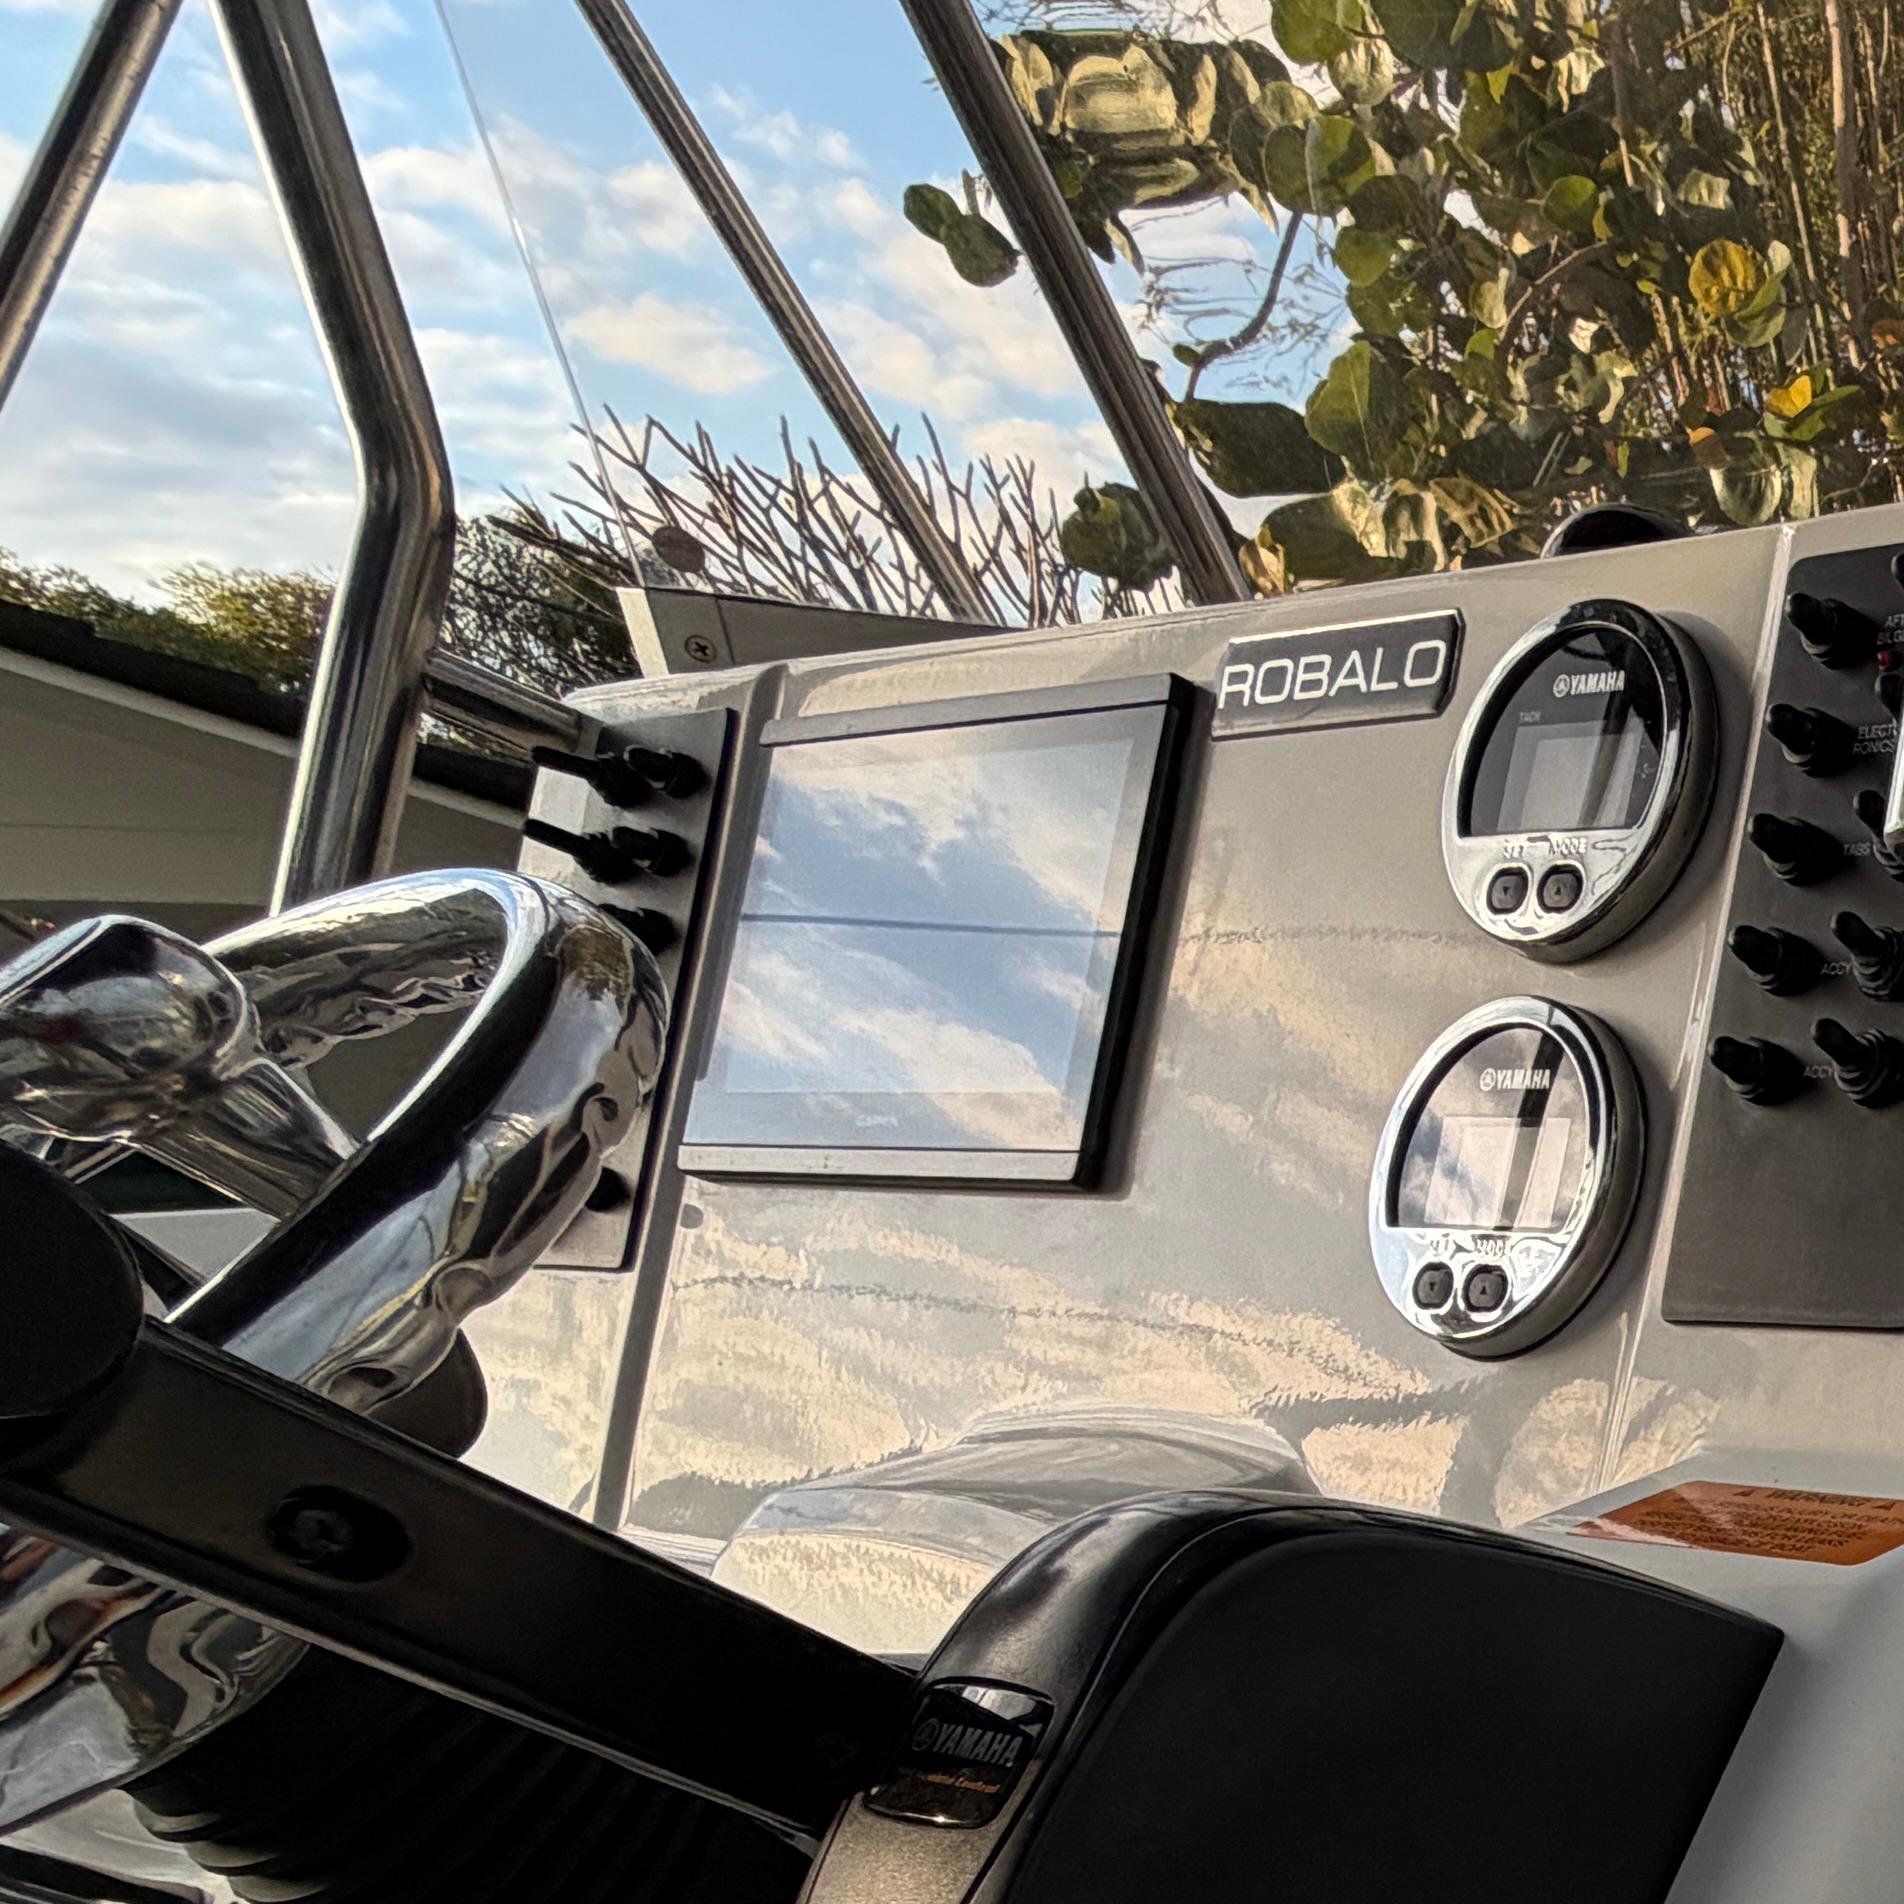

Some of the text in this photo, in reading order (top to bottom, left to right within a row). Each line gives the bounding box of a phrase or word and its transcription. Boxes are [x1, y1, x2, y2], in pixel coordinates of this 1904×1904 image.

[1217, 639, 1446, 710] ROBALO
[1570, 669, 1625, 695] YAMAHA
[1496, 1068, 1550, 1091] YAMAHA
[933, 1723, 1023, 1767] YAMAHA
